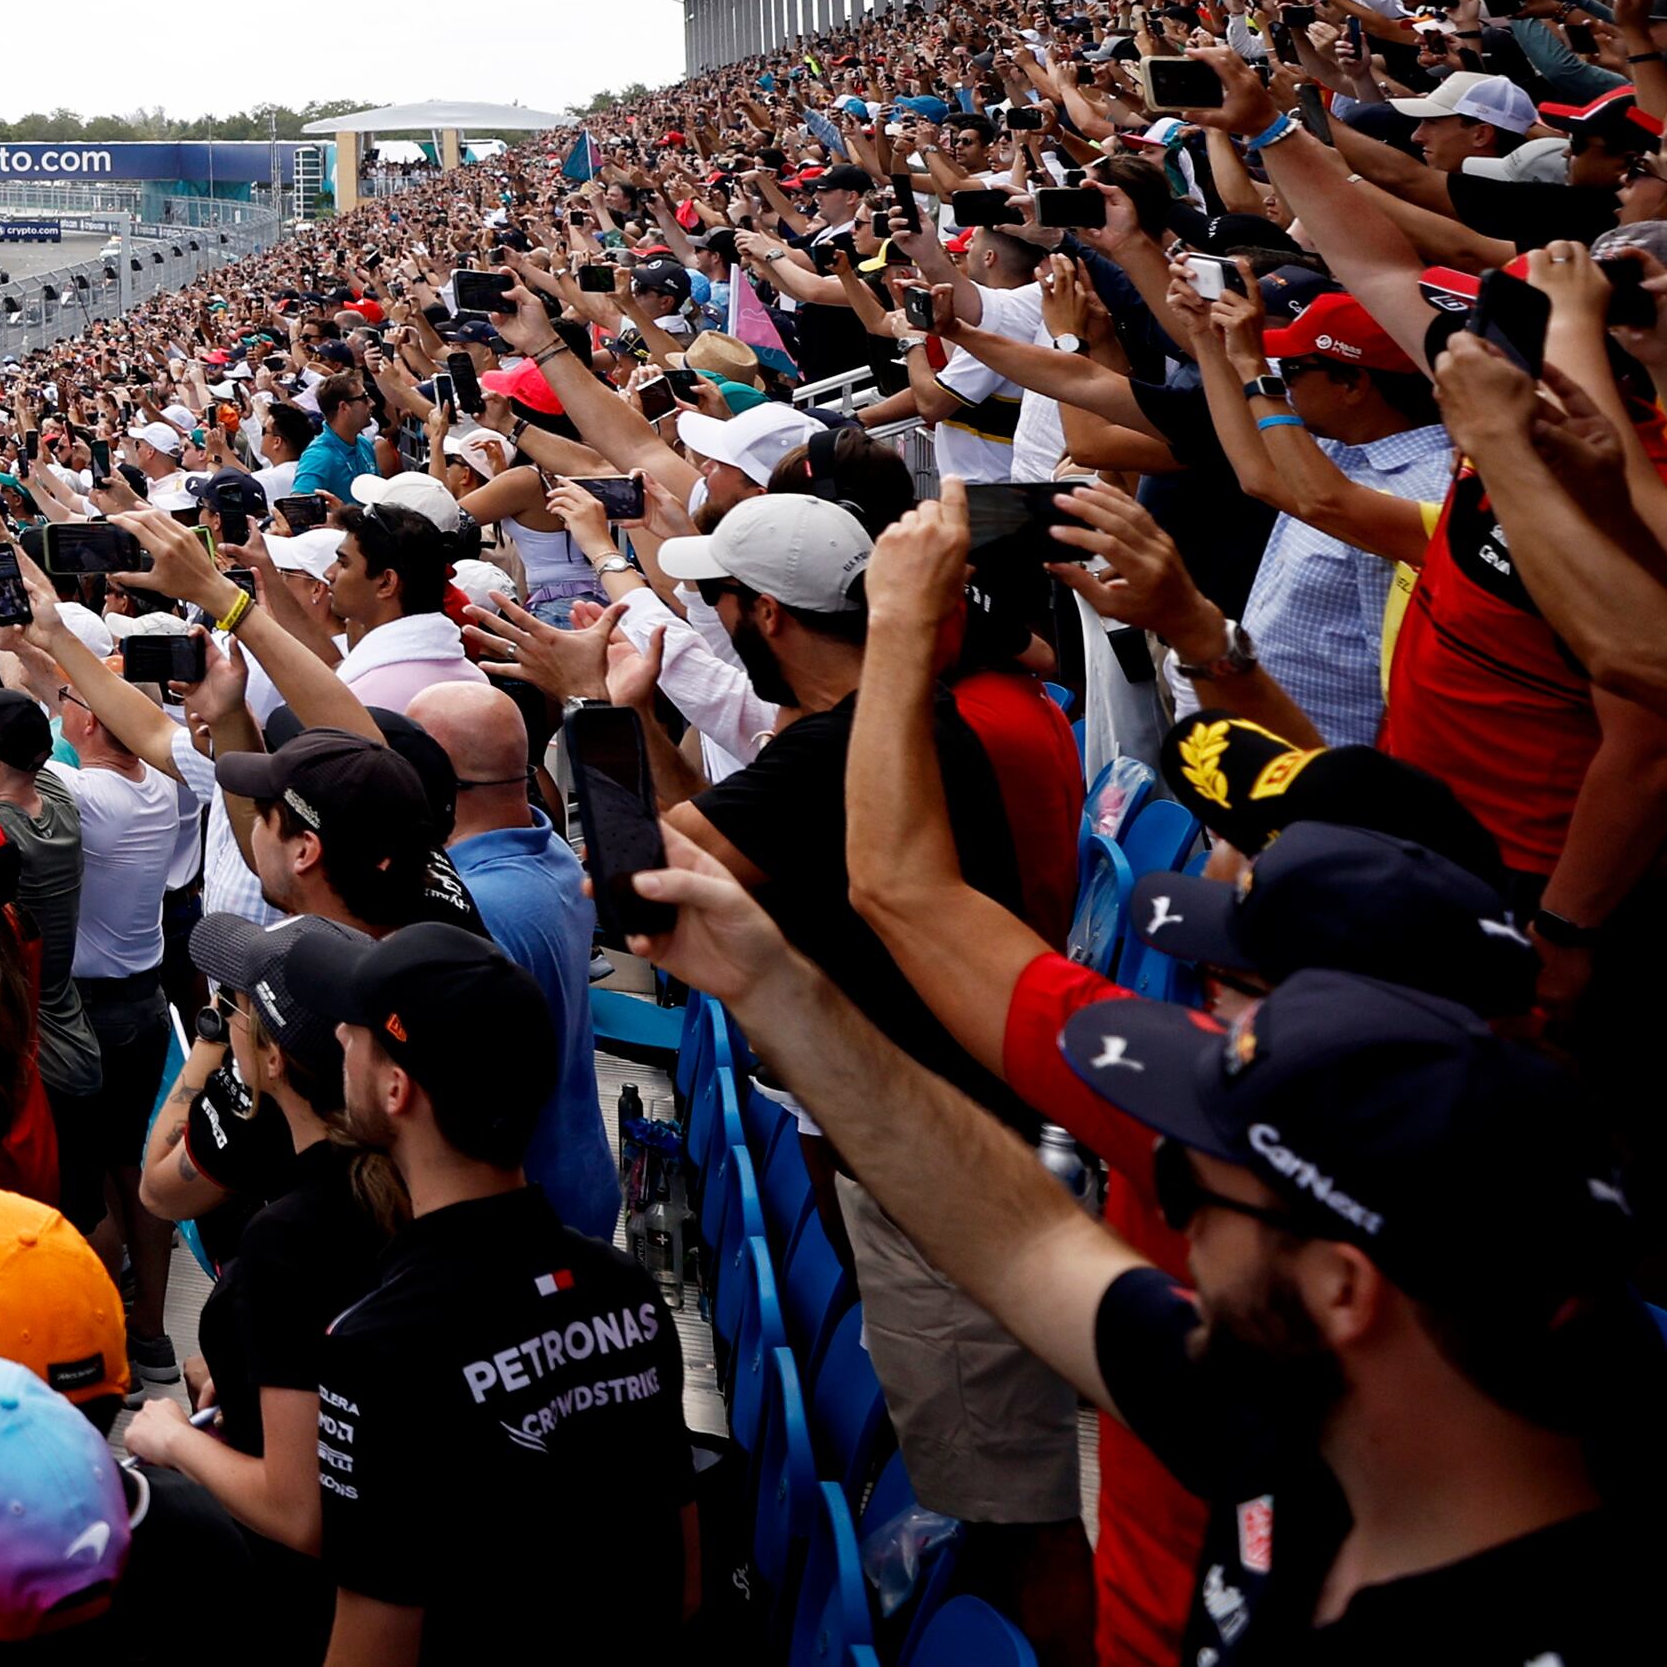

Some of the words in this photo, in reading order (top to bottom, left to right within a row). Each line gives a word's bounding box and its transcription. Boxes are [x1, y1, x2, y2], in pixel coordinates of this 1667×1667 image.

[6, 226, 59, 237] crypto.com
[1333, 339, 1363, 355] Haas
[1246, 1122, 1388, 1236] CarNext
[463, 1302, 659, 1404] PETRONAS
[520, 1365, 660, 1438] CROWDSTRIKE
